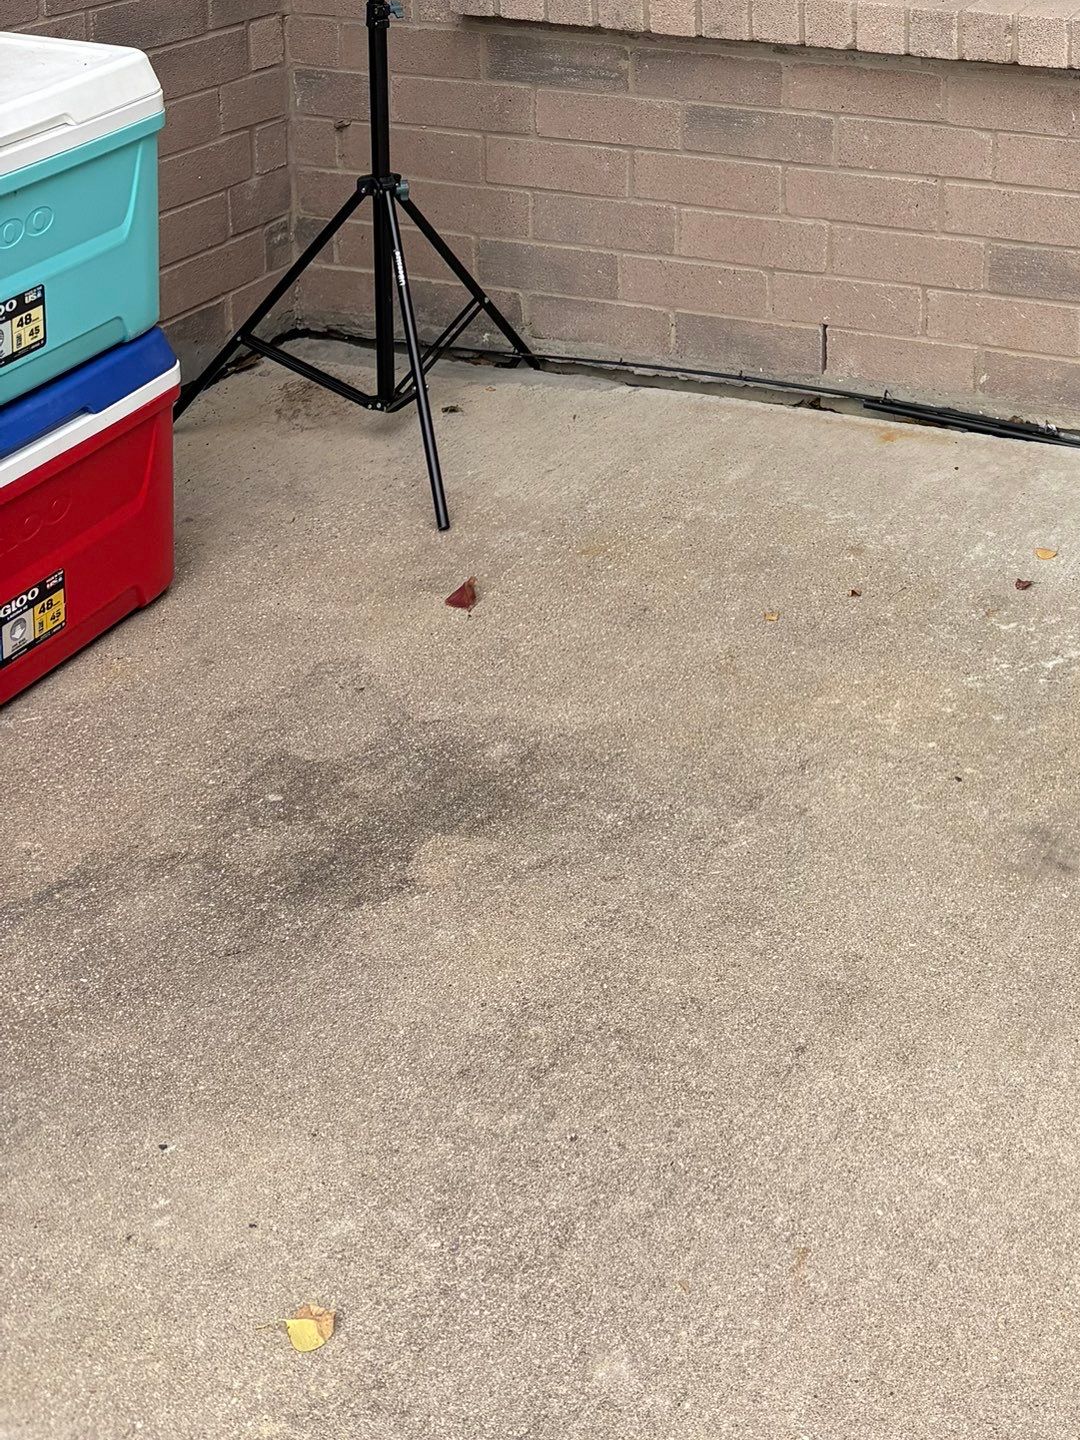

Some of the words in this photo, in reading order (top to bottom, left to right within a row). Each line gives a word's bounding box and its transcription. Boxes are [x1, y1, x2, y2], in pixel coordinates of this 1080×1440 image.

[17, 313, 32, 328] 48
[28, 325, 41, 337] 45
[38, 598, 53, 614] 48
[50, 609, 62, 621] 45
